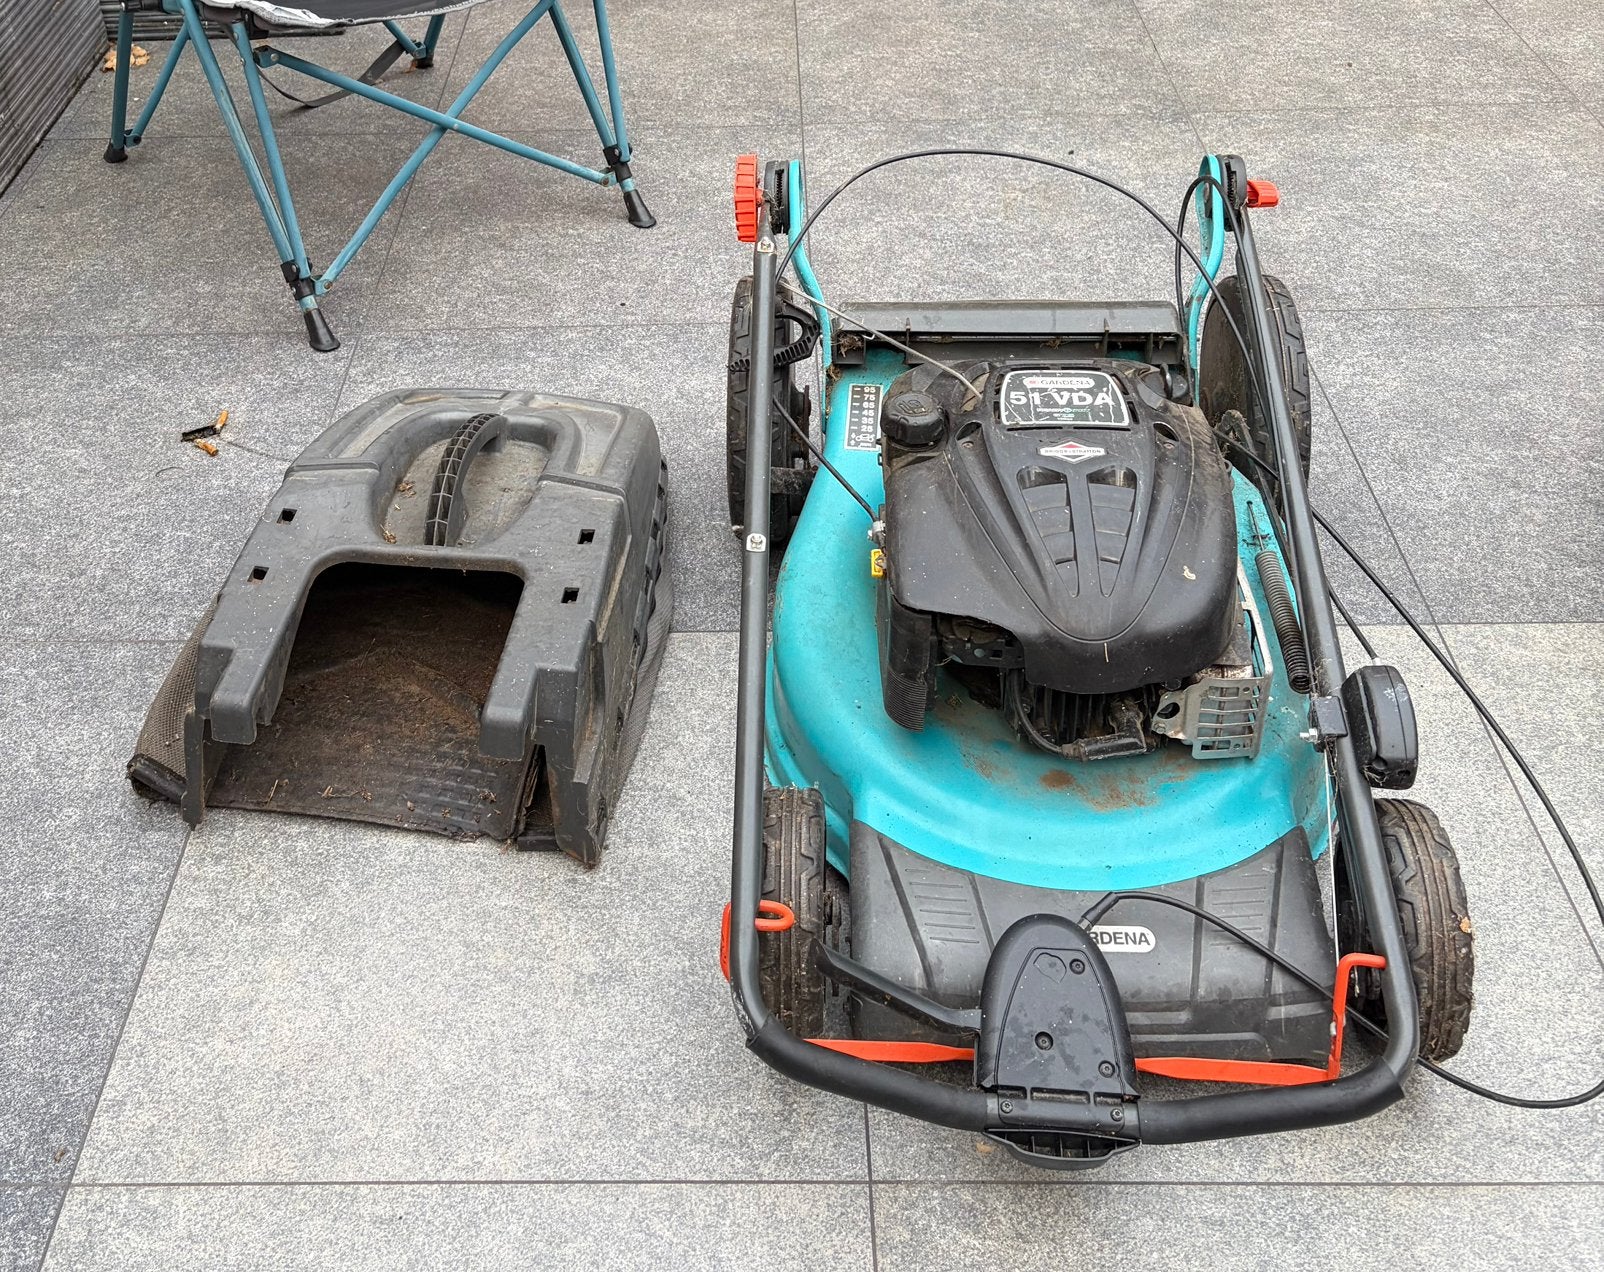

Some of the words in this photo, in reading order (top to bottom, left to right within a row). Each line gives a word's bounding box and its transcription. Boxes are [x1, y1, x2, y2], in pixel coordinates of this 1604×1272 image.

[1009, 391, 1041, 405] 51
[1050, 391, 1115, 406] VDA
[1089, 931, 1151, 946] RDENA
